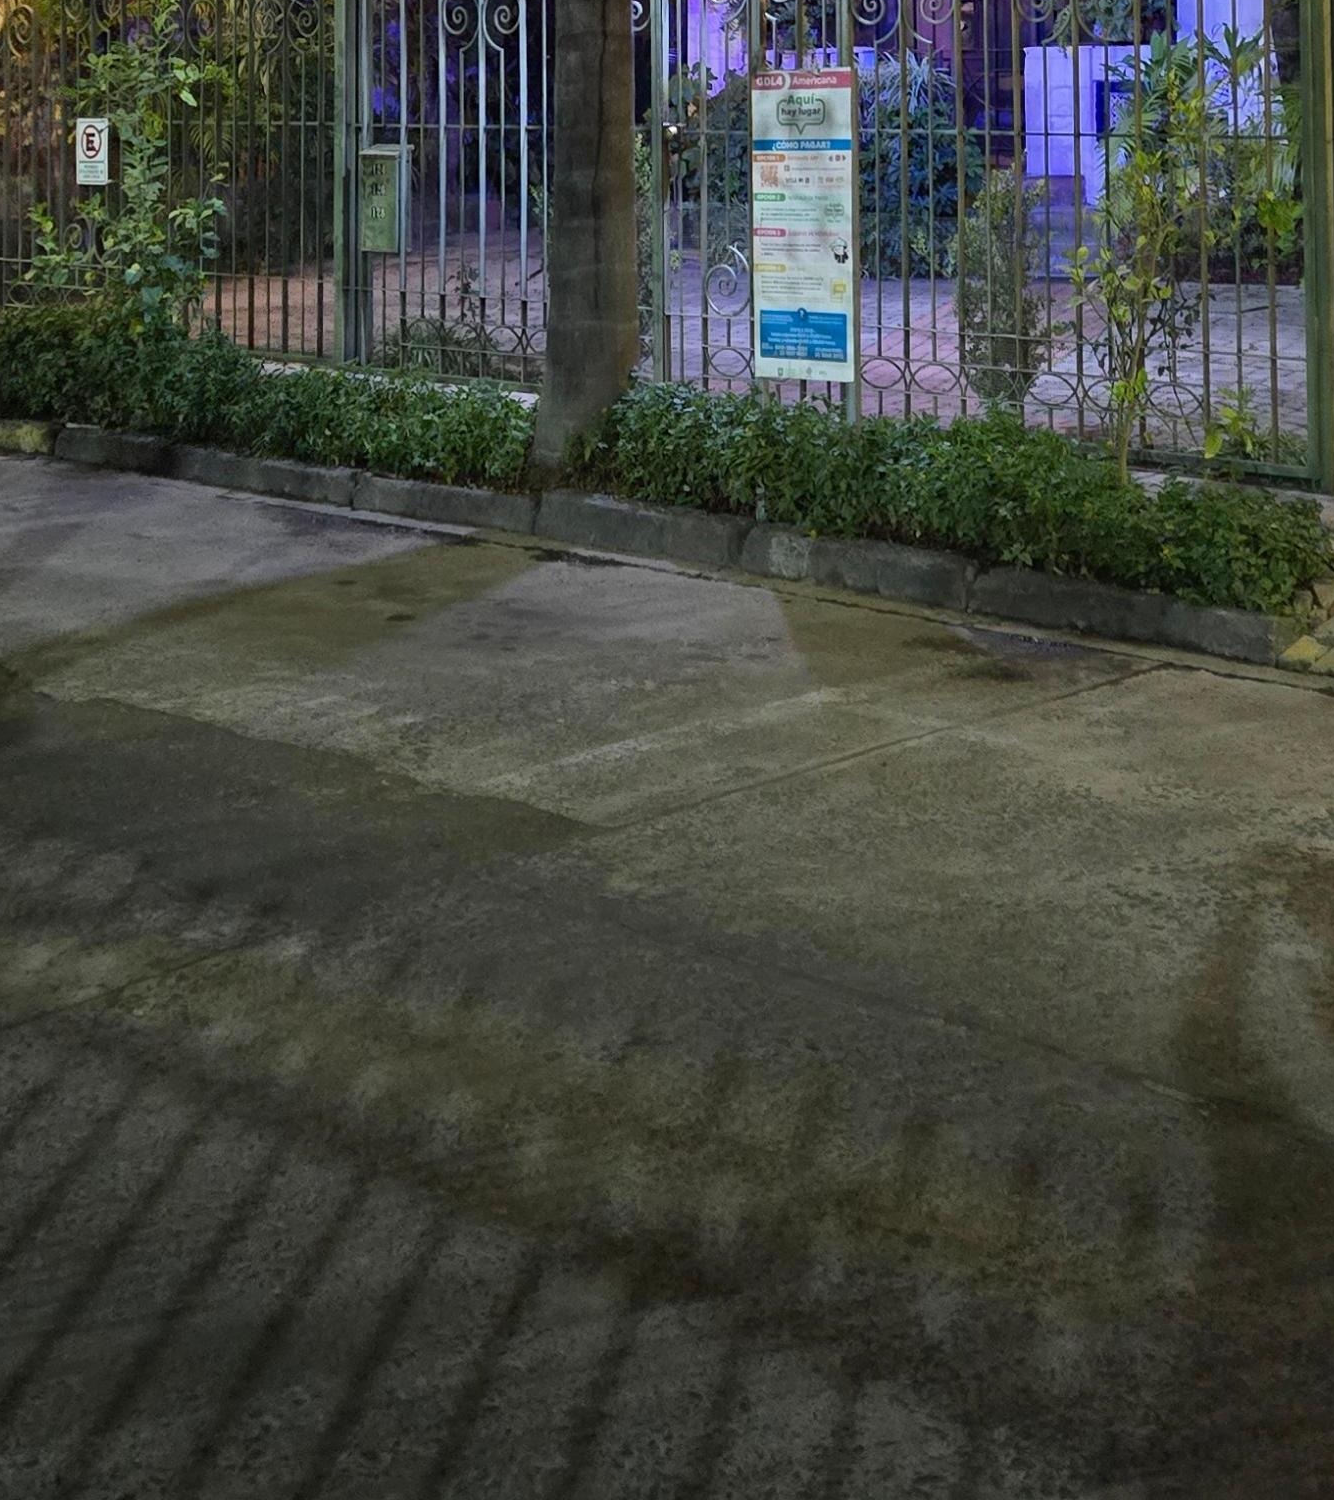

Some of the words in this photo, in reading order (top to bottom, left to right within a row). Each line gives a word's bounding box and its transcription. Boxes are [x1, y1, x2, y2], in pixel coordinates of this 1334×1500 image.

[792, 75, 837, 86] Americana
[787, 93, 815, 106] Aquí
[781, 107, 797, 117] hay
[798, 107, 821, 117] lugar
[800, 140, 831, 149] PAGAR?
